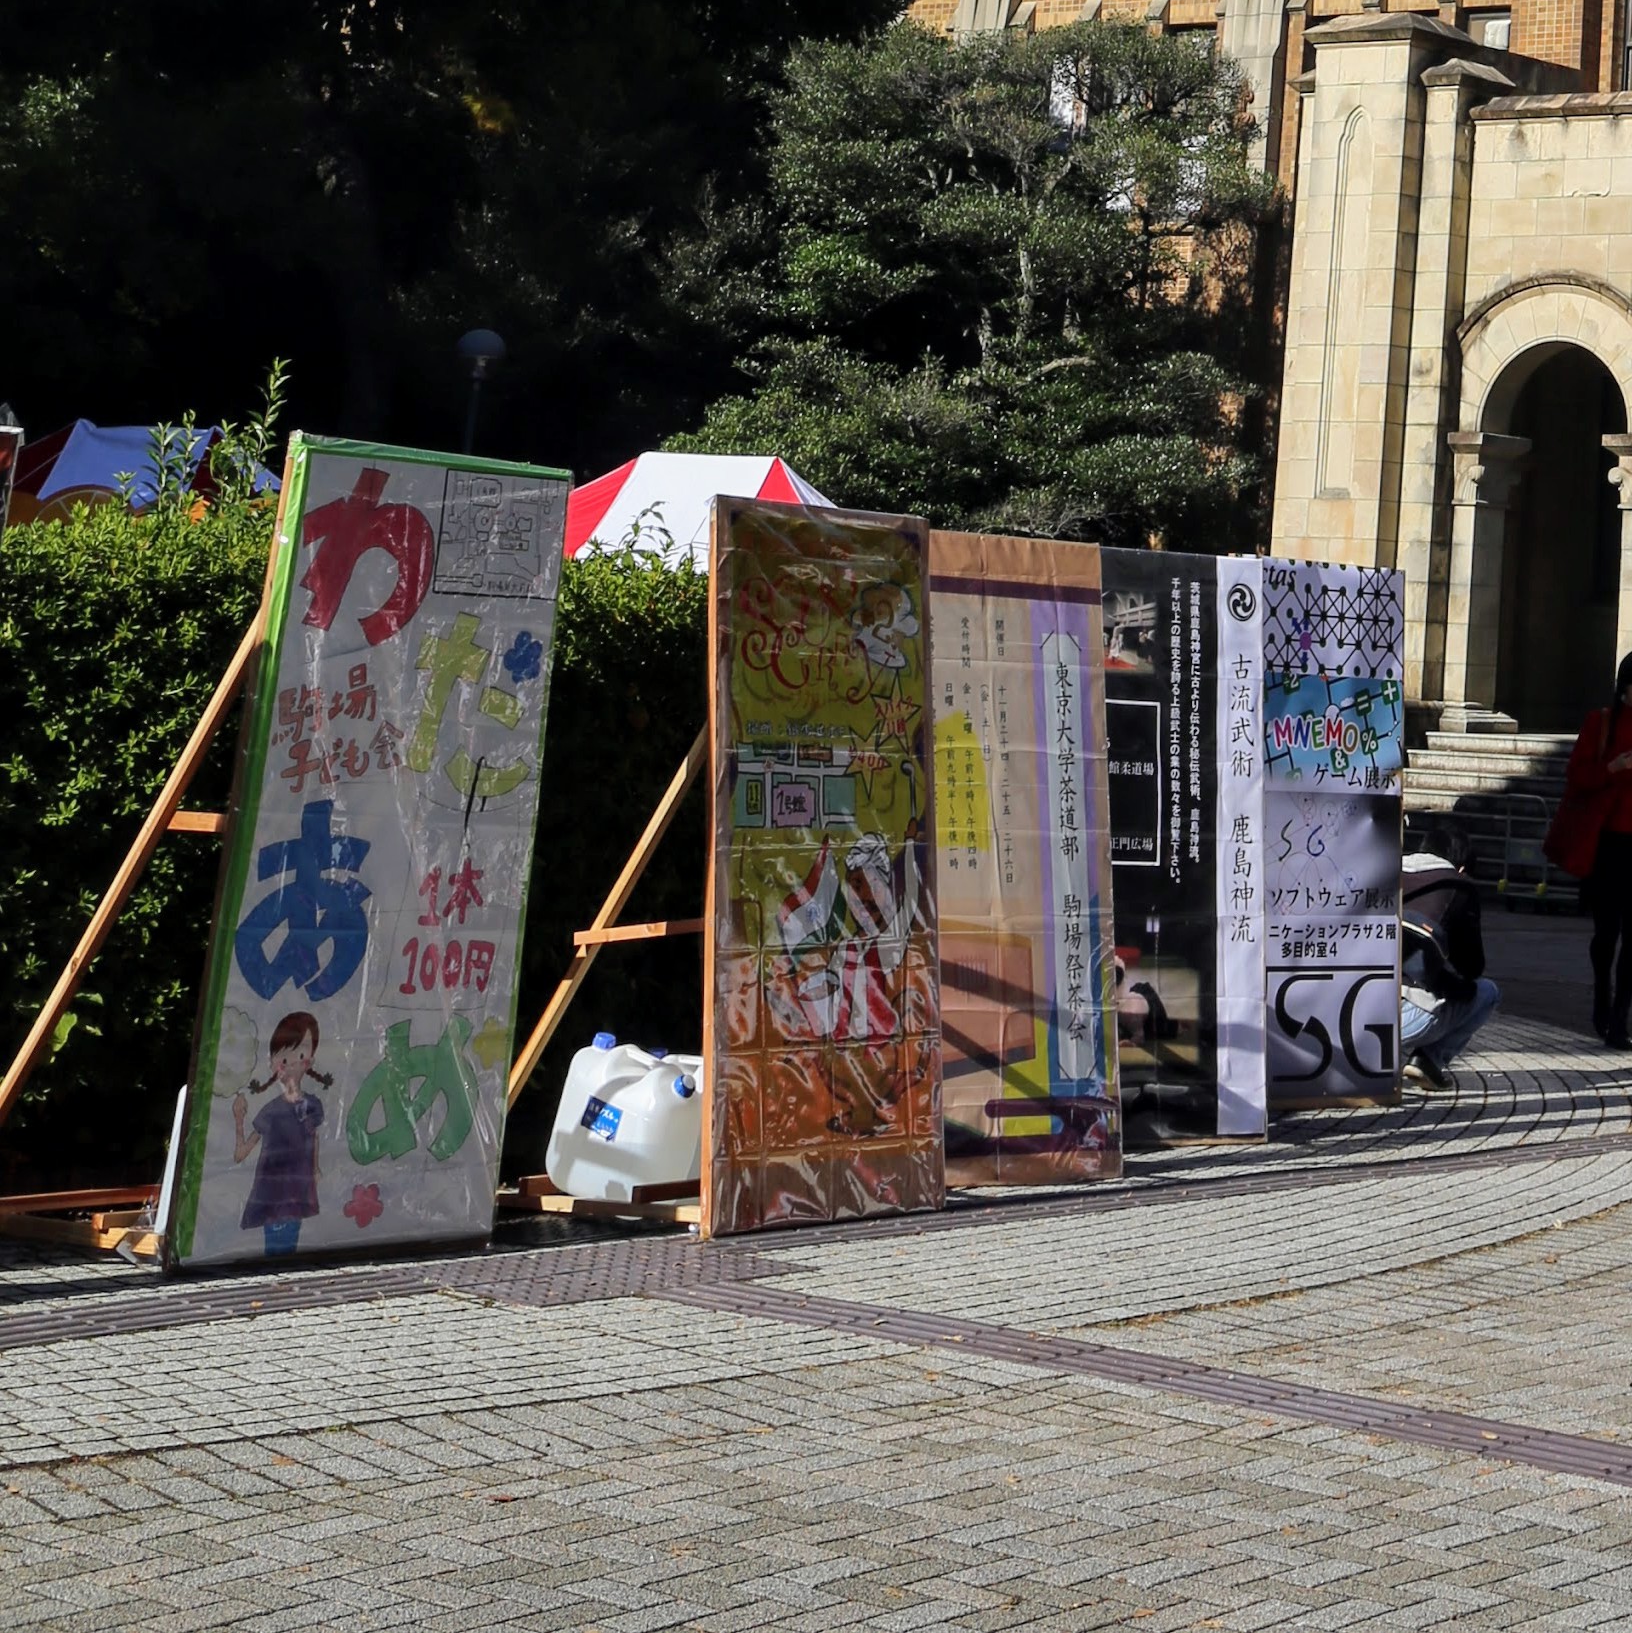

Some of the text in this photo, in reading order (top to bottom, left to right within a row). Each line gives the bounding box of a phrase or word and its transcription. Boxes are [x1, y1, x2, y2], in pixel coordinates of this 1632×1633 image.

[273, 663, 377, 745] 駒場
[1275, 714, 1360, 754] MNEMO
[1229, 653, 1256, 943] 古流武術 鹿島神流
[1314, 762, 1396, 788] ゲーム展示
[1055, 662, 1087, 1041] 東京大学茶道部 駒場祭茶会
[418, 857, 484, 926] 1本
[1271, 886, 1395, 909] ソフトウェア展示
[400, 936, 496, 995] 100円
